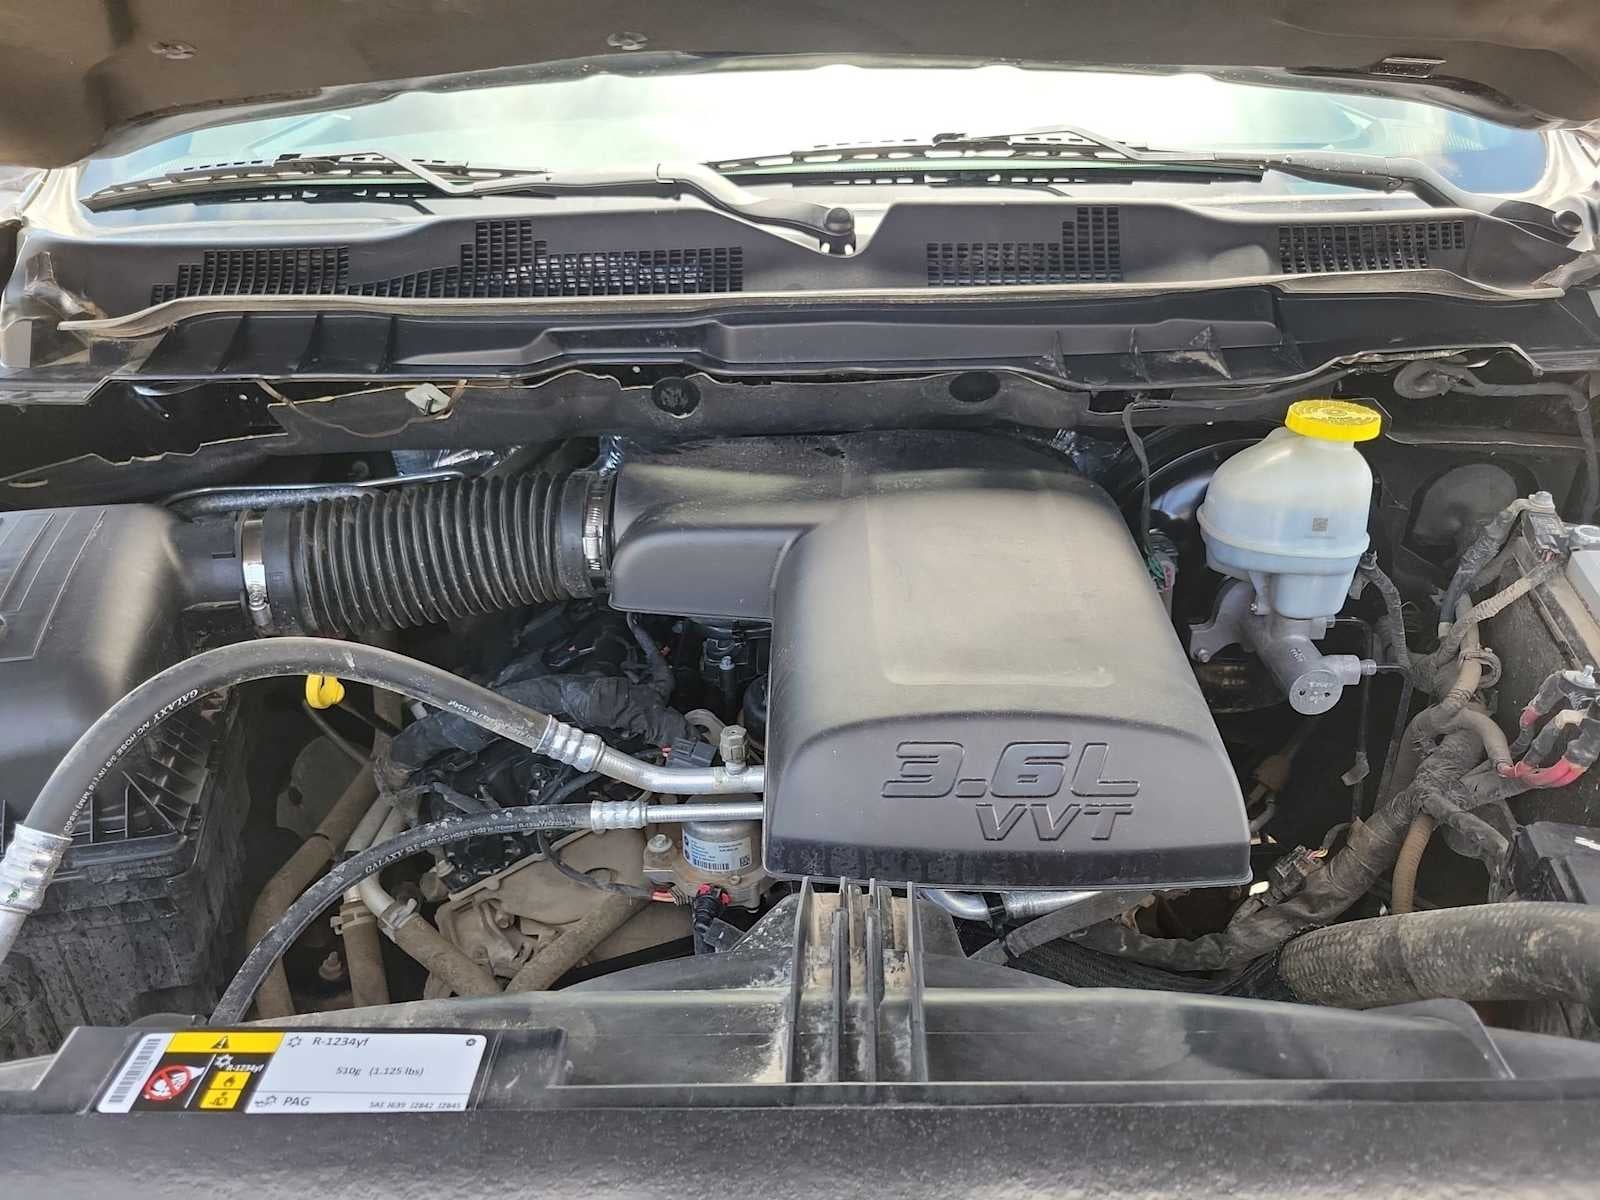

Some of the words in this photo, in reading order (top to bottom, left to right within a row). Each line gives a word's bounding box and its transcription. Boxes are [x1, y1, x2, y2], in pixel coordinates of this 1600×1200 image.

[153, 689, 199, 724] GALAXY
[116, 733, 137, 756] HOSE
[881, 740, 1141, 799] 3.6L
[975, 803, 1135, 842] VVT
[364, 850, 404, 874] GALAXY
[311, 1036, 370, 1049] R-1234yf
[369, 1066, 402, 1077] (1.125
[404, 1066, 424, 1077] lbs)
[283, 1096, 313, 1107] PAG
